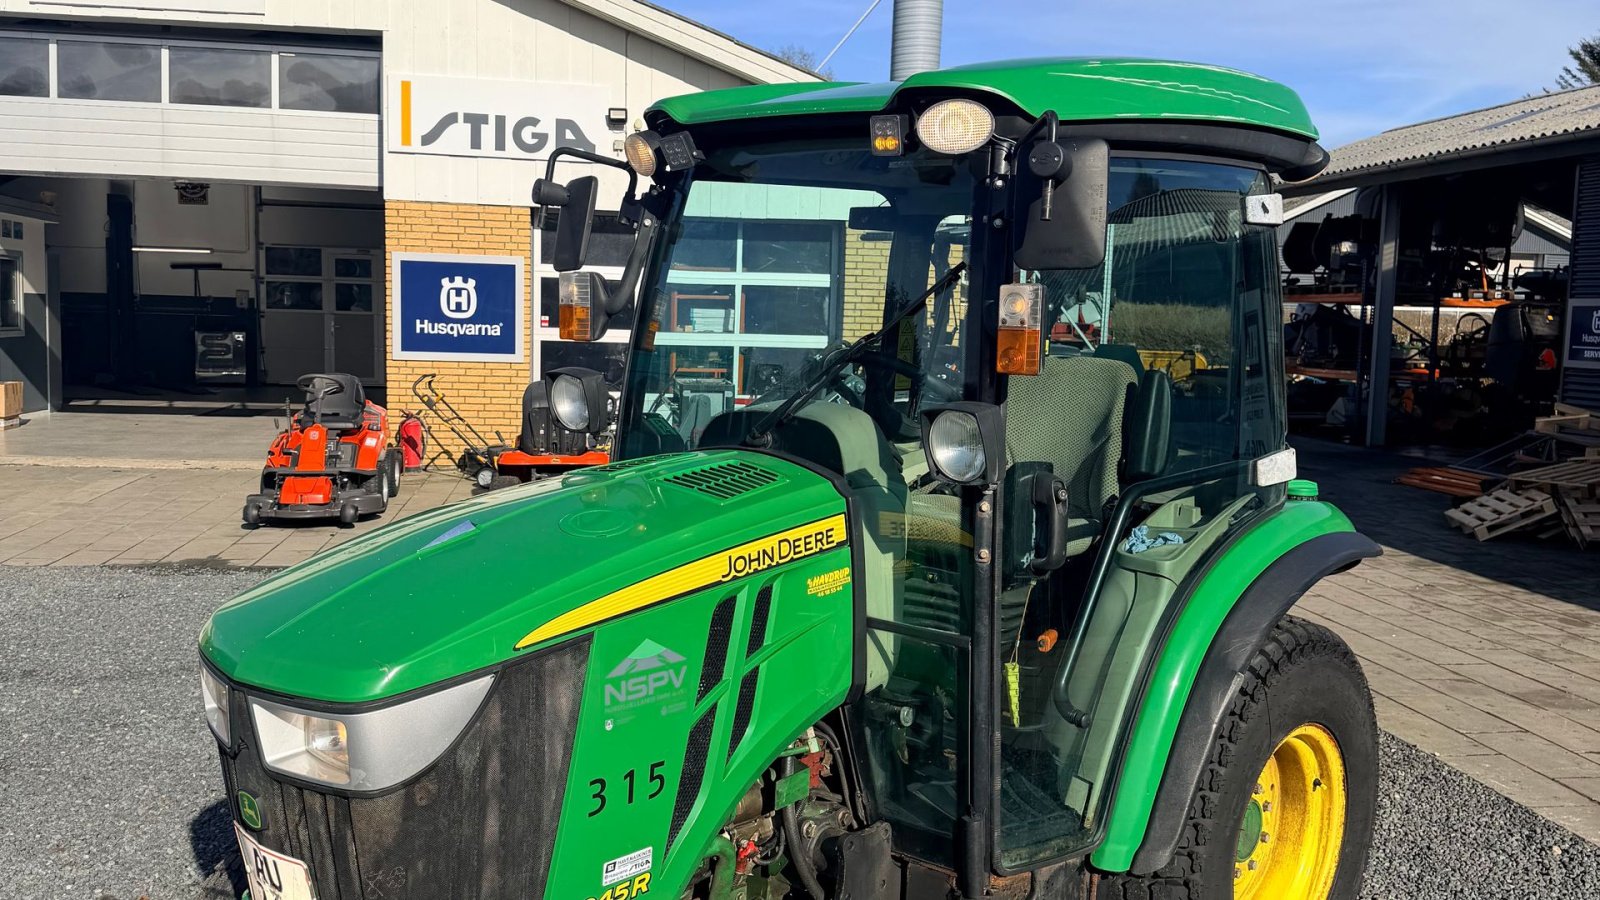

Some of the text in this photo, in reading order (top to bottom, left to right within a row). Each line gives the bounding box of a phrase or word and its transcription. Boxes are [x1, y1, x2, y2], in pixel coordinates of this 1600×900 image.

[421, 111, 595, 154] STIGA
[721, 527, 835, 579] JOHN DEERE
[812, 567, 849, 587] HAVDRUP
[604, 665, 688, 707] NSPV
[253, 848, 282, 892] AU
